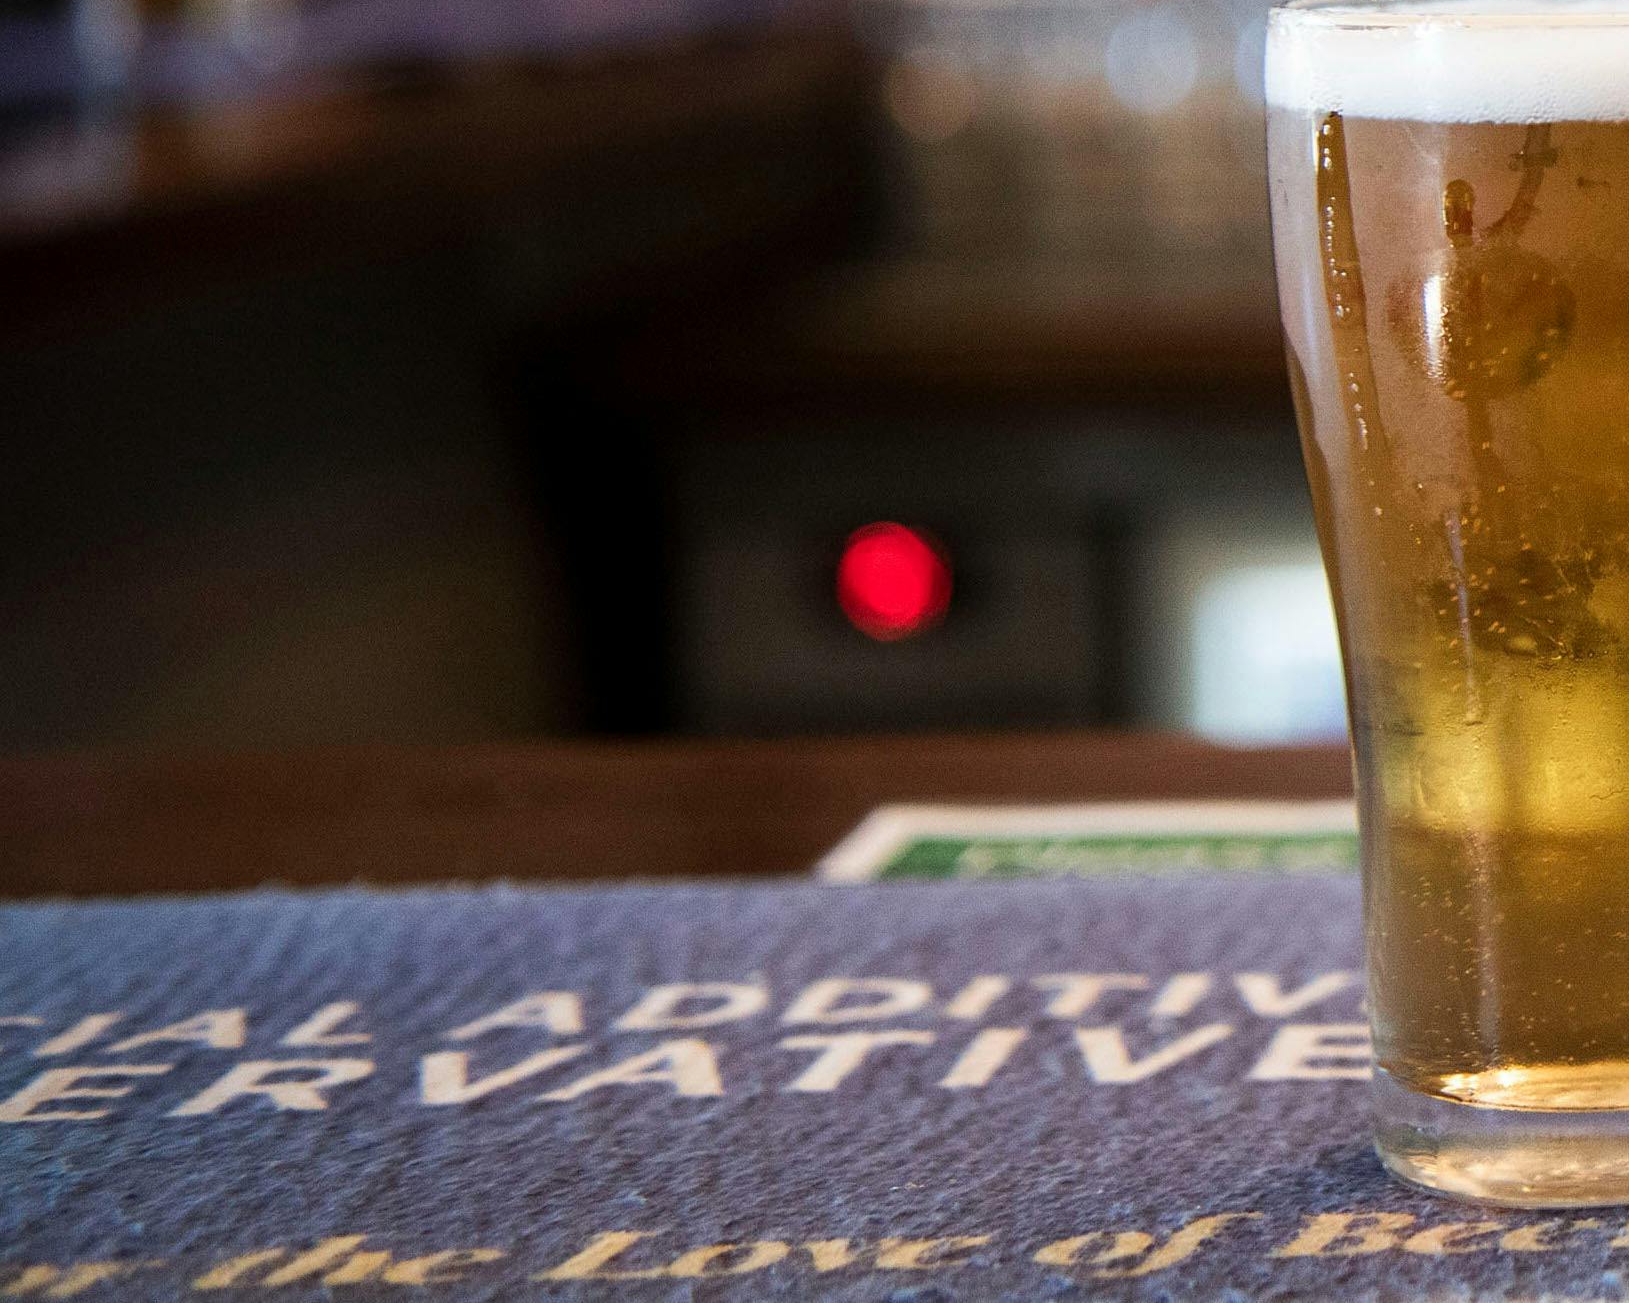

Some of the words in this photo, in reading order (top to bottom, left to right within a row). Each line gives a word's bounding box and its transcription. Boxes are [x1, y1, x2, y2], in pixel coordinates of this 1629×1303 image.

[440, 969, 1372, 1041] ADDITIV
[193, 1233, 502, 1290] the
[528, 1229, 993, 1281] Love
[1031, 1210, 1264, 1279] of
